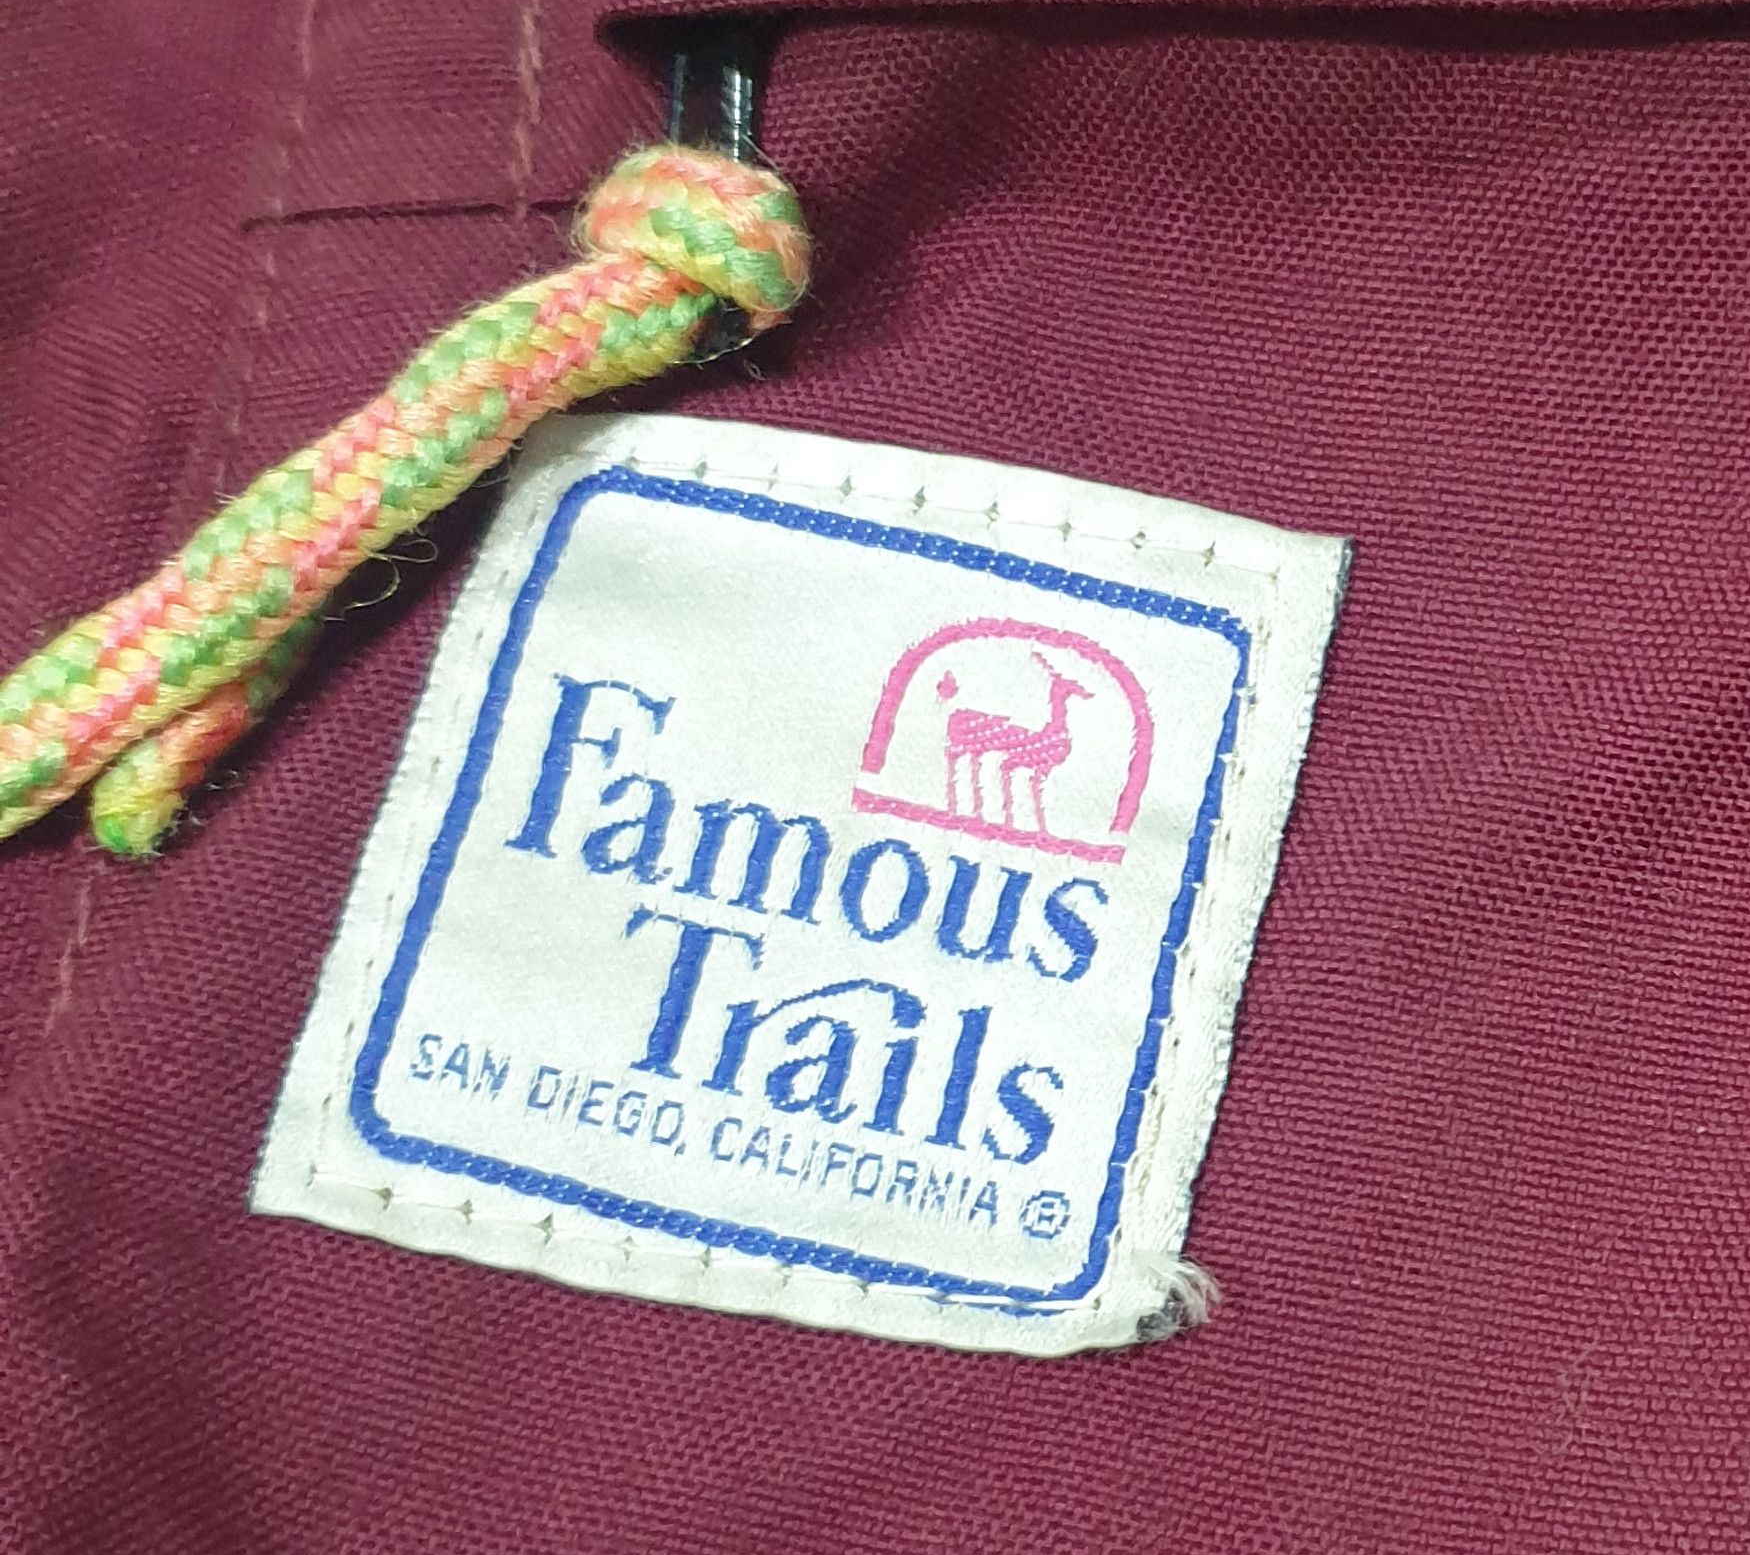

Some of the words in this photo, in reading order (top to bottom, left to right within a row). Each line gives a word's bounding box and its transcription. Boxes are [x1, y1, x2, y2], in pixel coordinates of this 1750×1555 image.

[505, 672, 1110, 985] Famous
[408, 1033, 506, 1104] SAN
[525, 1061, 687, 1156] DIEGO,
[709, 1114, 999, 1232] CALIFORNIA
[624, 904, 1064, 1166] Trails
